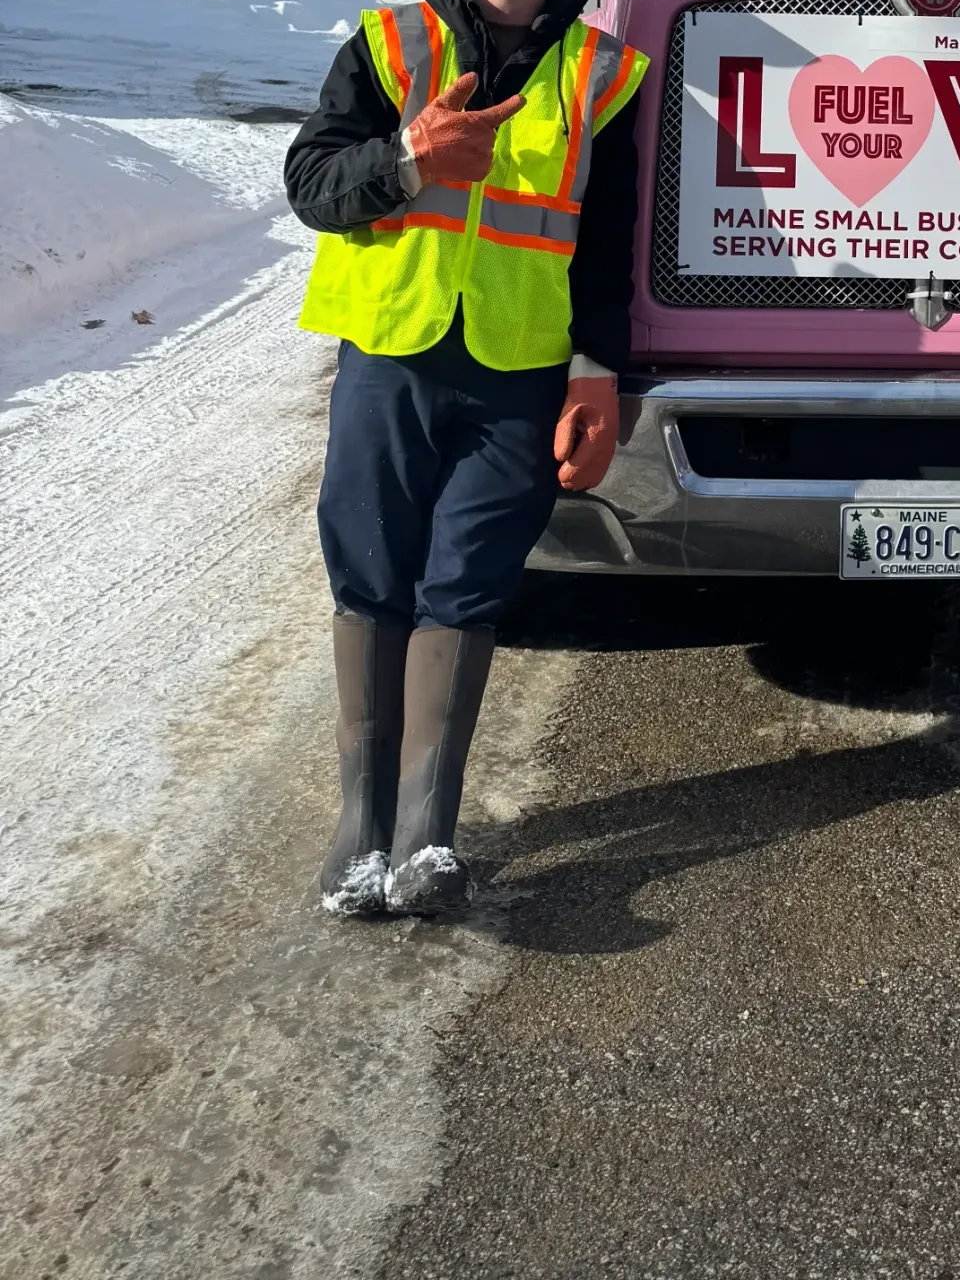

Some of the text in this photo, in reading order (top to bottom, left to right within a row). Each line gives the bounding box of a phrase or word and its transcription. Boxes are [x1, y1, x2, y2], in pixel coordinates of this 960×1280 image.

[813, 84, 914, 125] FUEL
[821, 132, 903, 160] YOUR
[713, 207, 804, 230] MAINE
[814, 209, 909, 232] SMALL
[712, 235, 838, 258] SERVING
[846, 237, 930, 260] THEIR
[899, 511, 948, 523] MAINE
